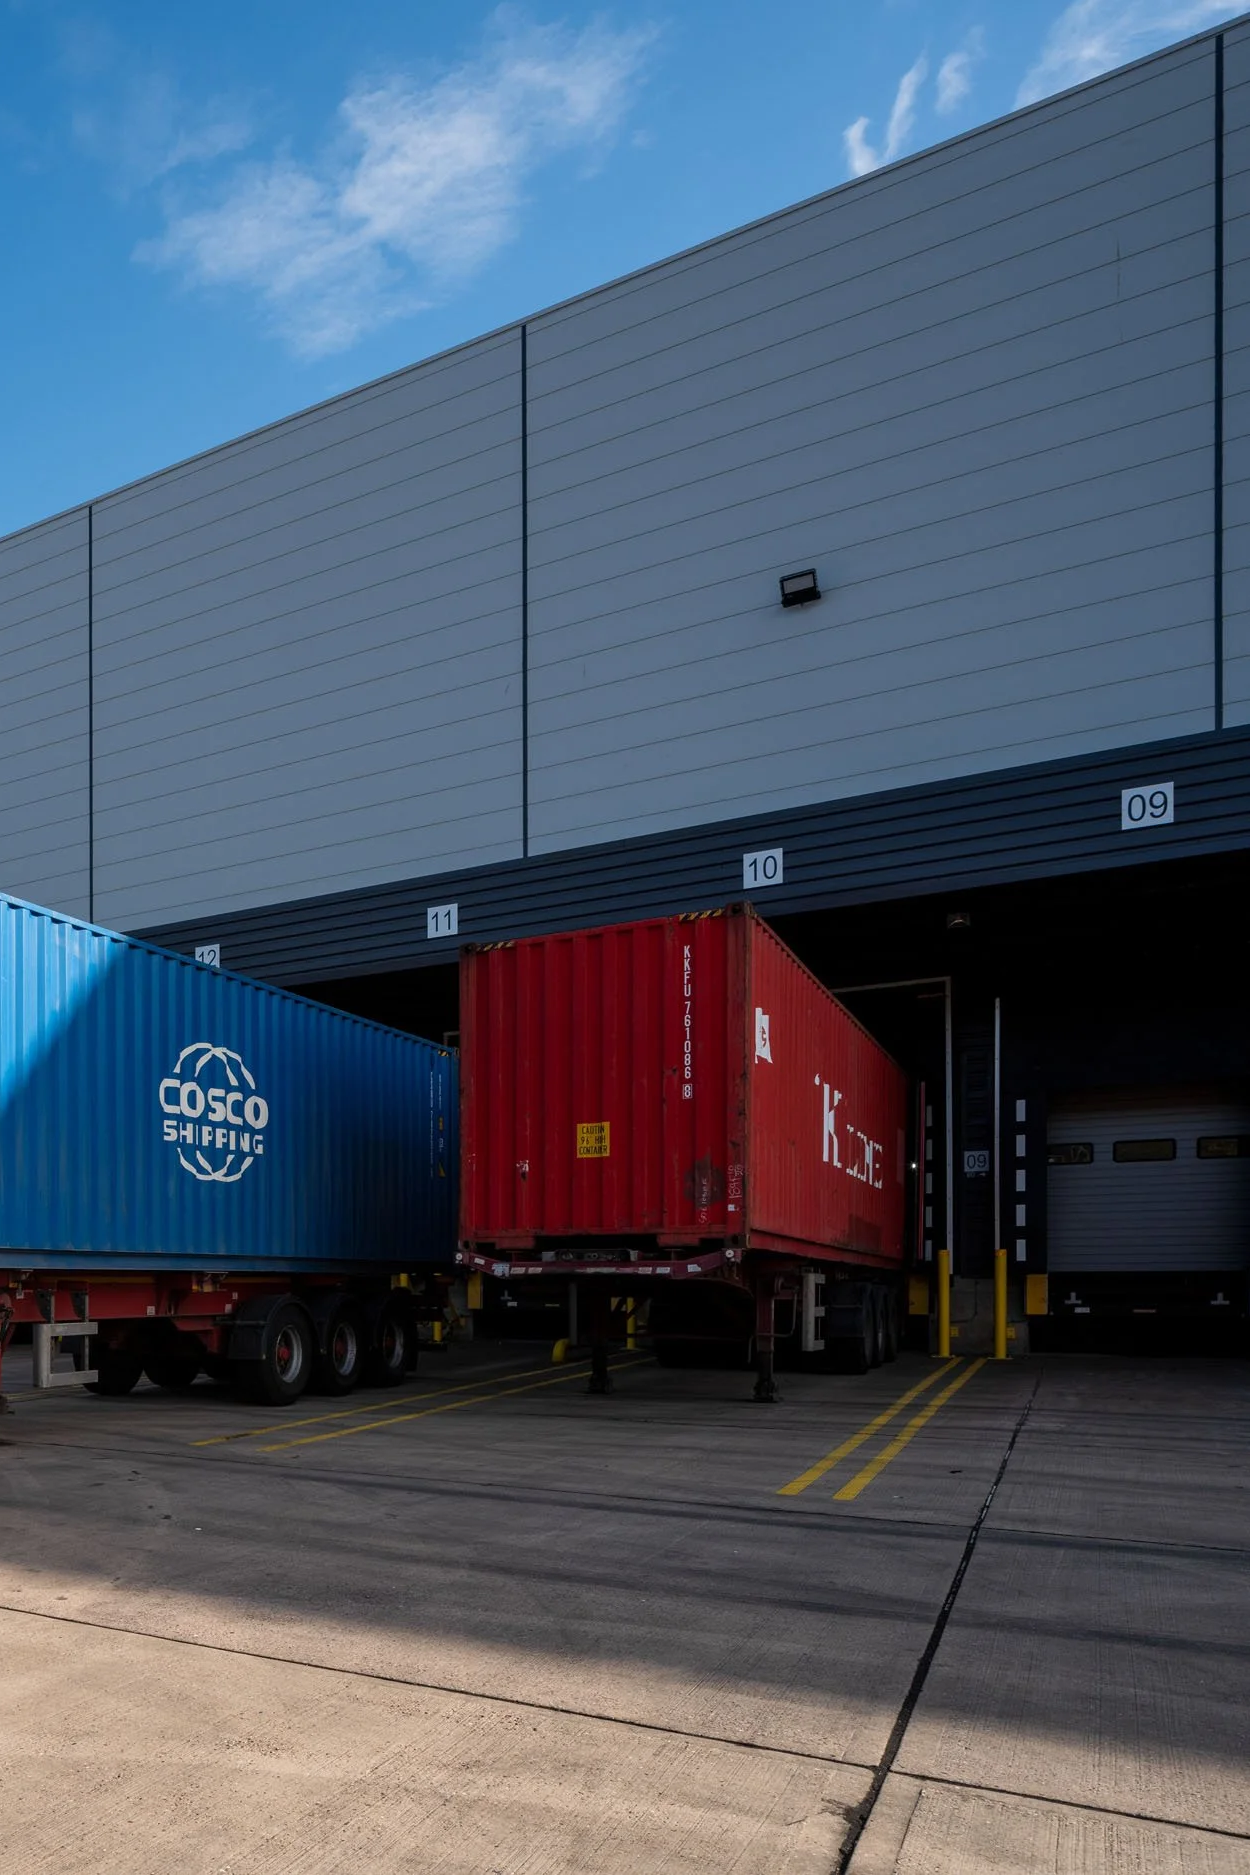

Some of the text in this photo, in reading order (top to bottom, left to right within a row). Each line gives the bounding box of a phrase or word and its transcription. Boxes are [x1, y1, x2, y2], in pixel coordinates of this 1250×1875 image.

[1127, 790, 1168, 822] 09
[748, 855, 778, 882] 10
[431, 909, 451, 933] 11
[198, 949, 217, 966] 12
[683, 944, 692, 1098] KKFU 761086 8
[159, 1078, 269, 1129] COSCO
[163, 1119, 264, 1155] SHIPPING
